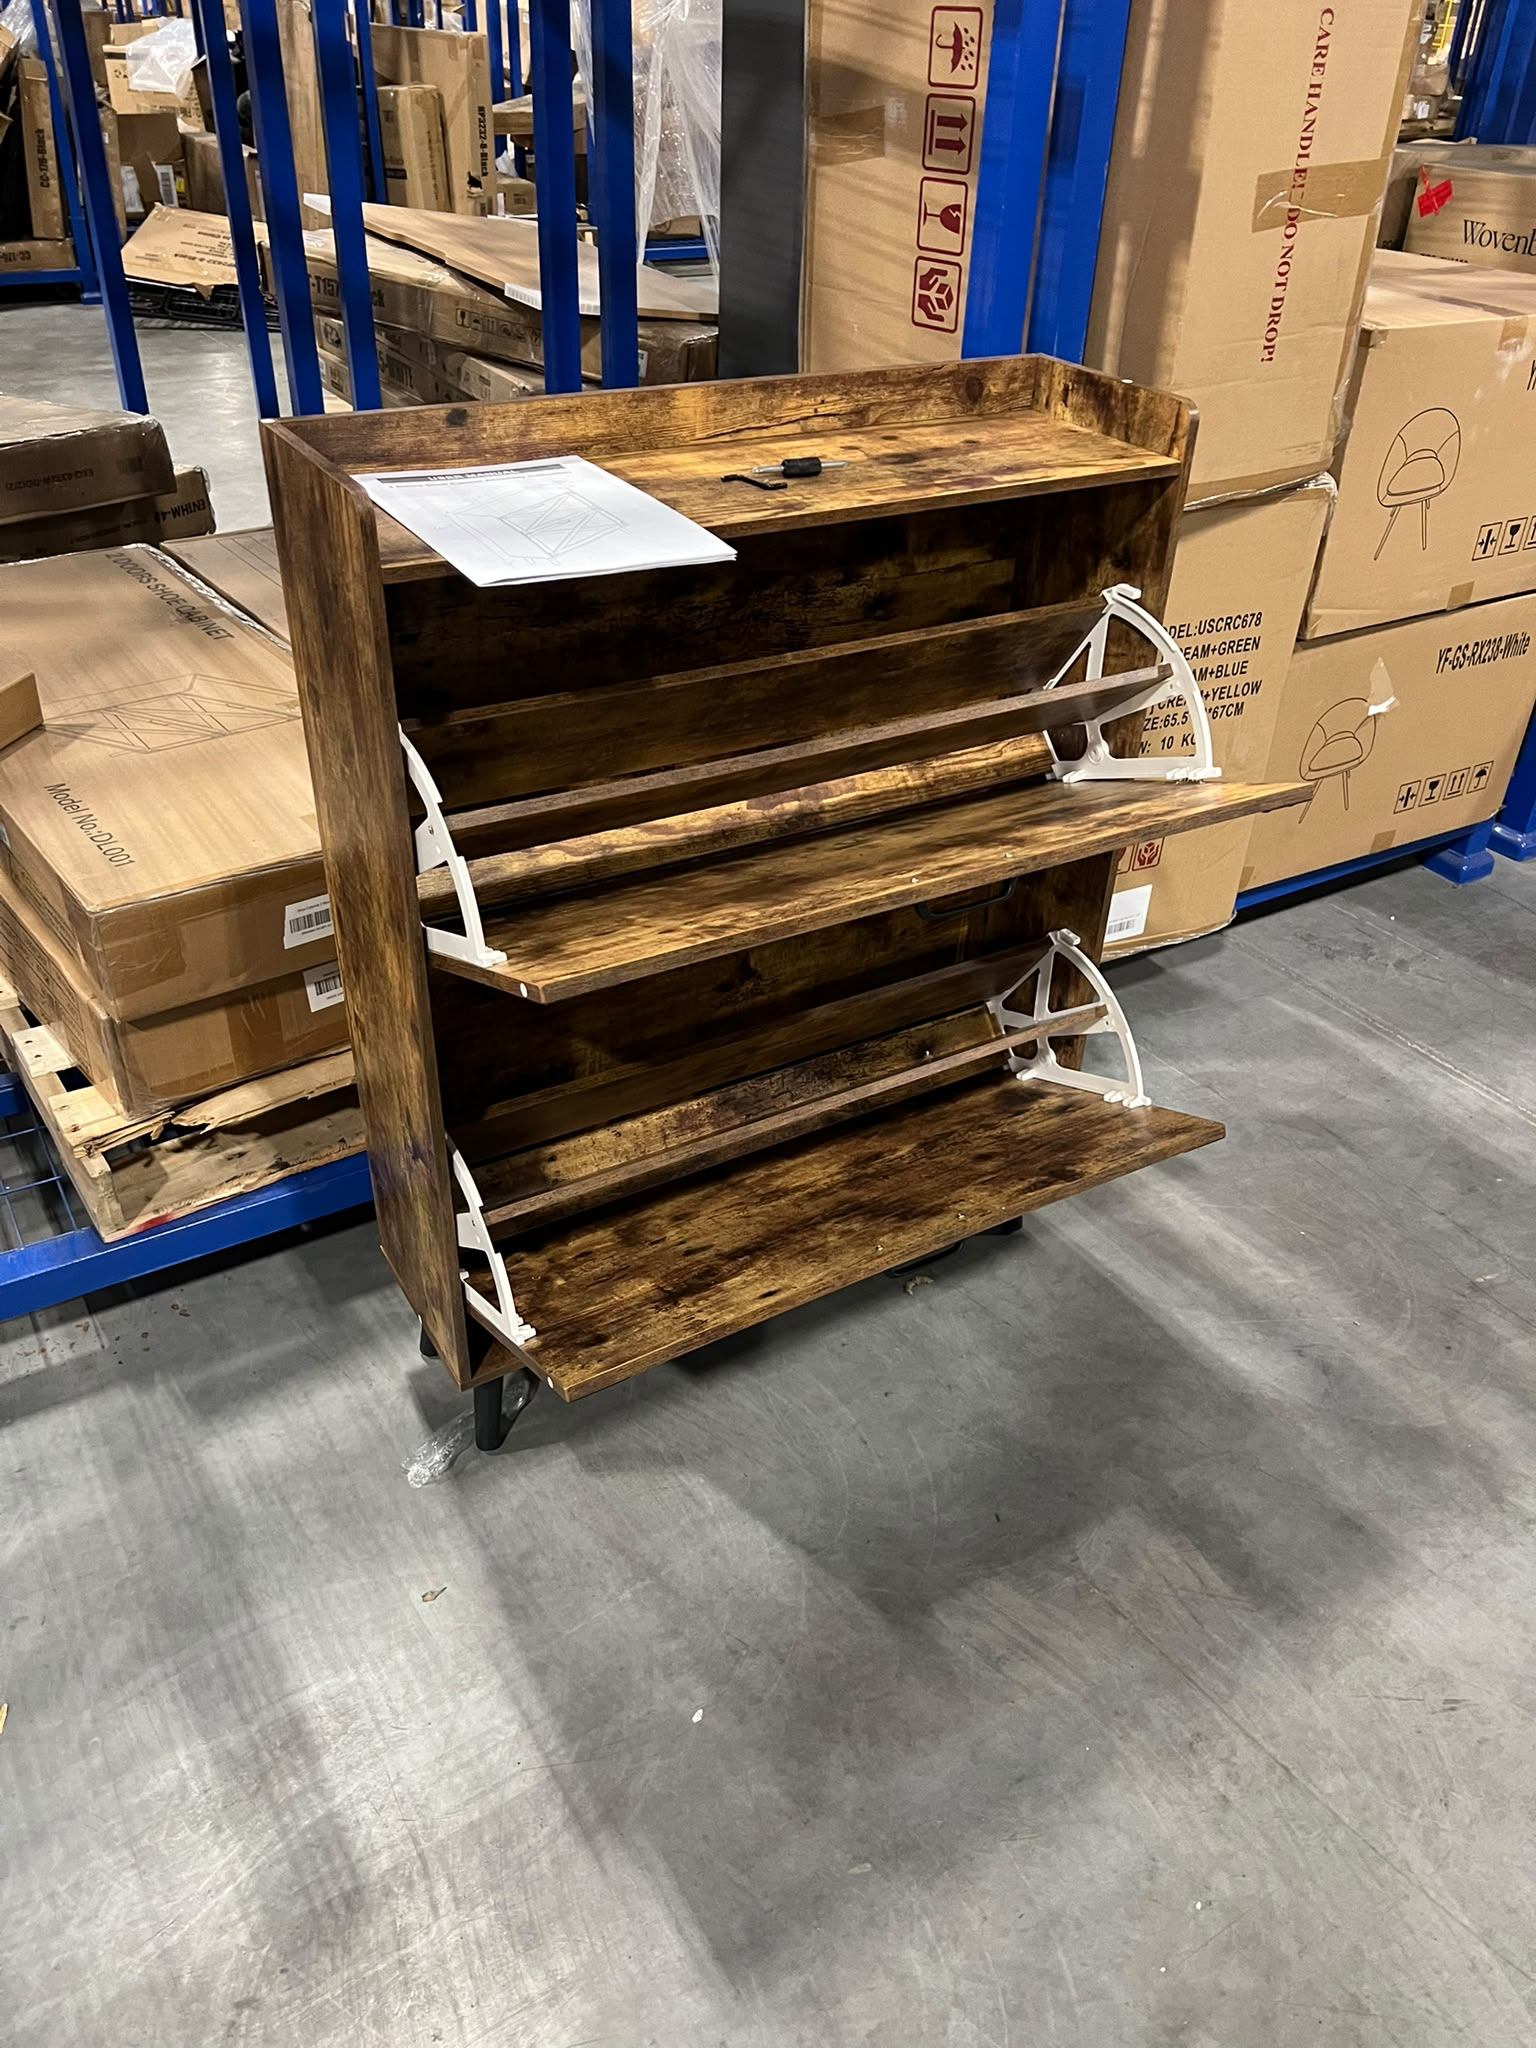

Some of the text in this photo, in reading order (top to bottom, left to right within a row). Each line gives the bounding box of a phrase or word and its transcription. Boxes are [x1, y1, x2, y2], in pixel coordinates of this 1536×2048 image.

[1261, 7, 1334, 363] CARE HANDLE! DO NOT DROP!
[112, 557, 157, 584] DOORS
[147, 583, 187, 606] SHOE
[176, 606, 235, 640] CABINET
[1163, 612, 1263, 640] DEL:USCRC678
[1180, 636, 1261, 661] EAM+GREEN
[1436, 632, 1531, 674] YF-GS-RX238-White
[1160, 735, 1174, 750] 10
[44, 783, 89, 814] Model
